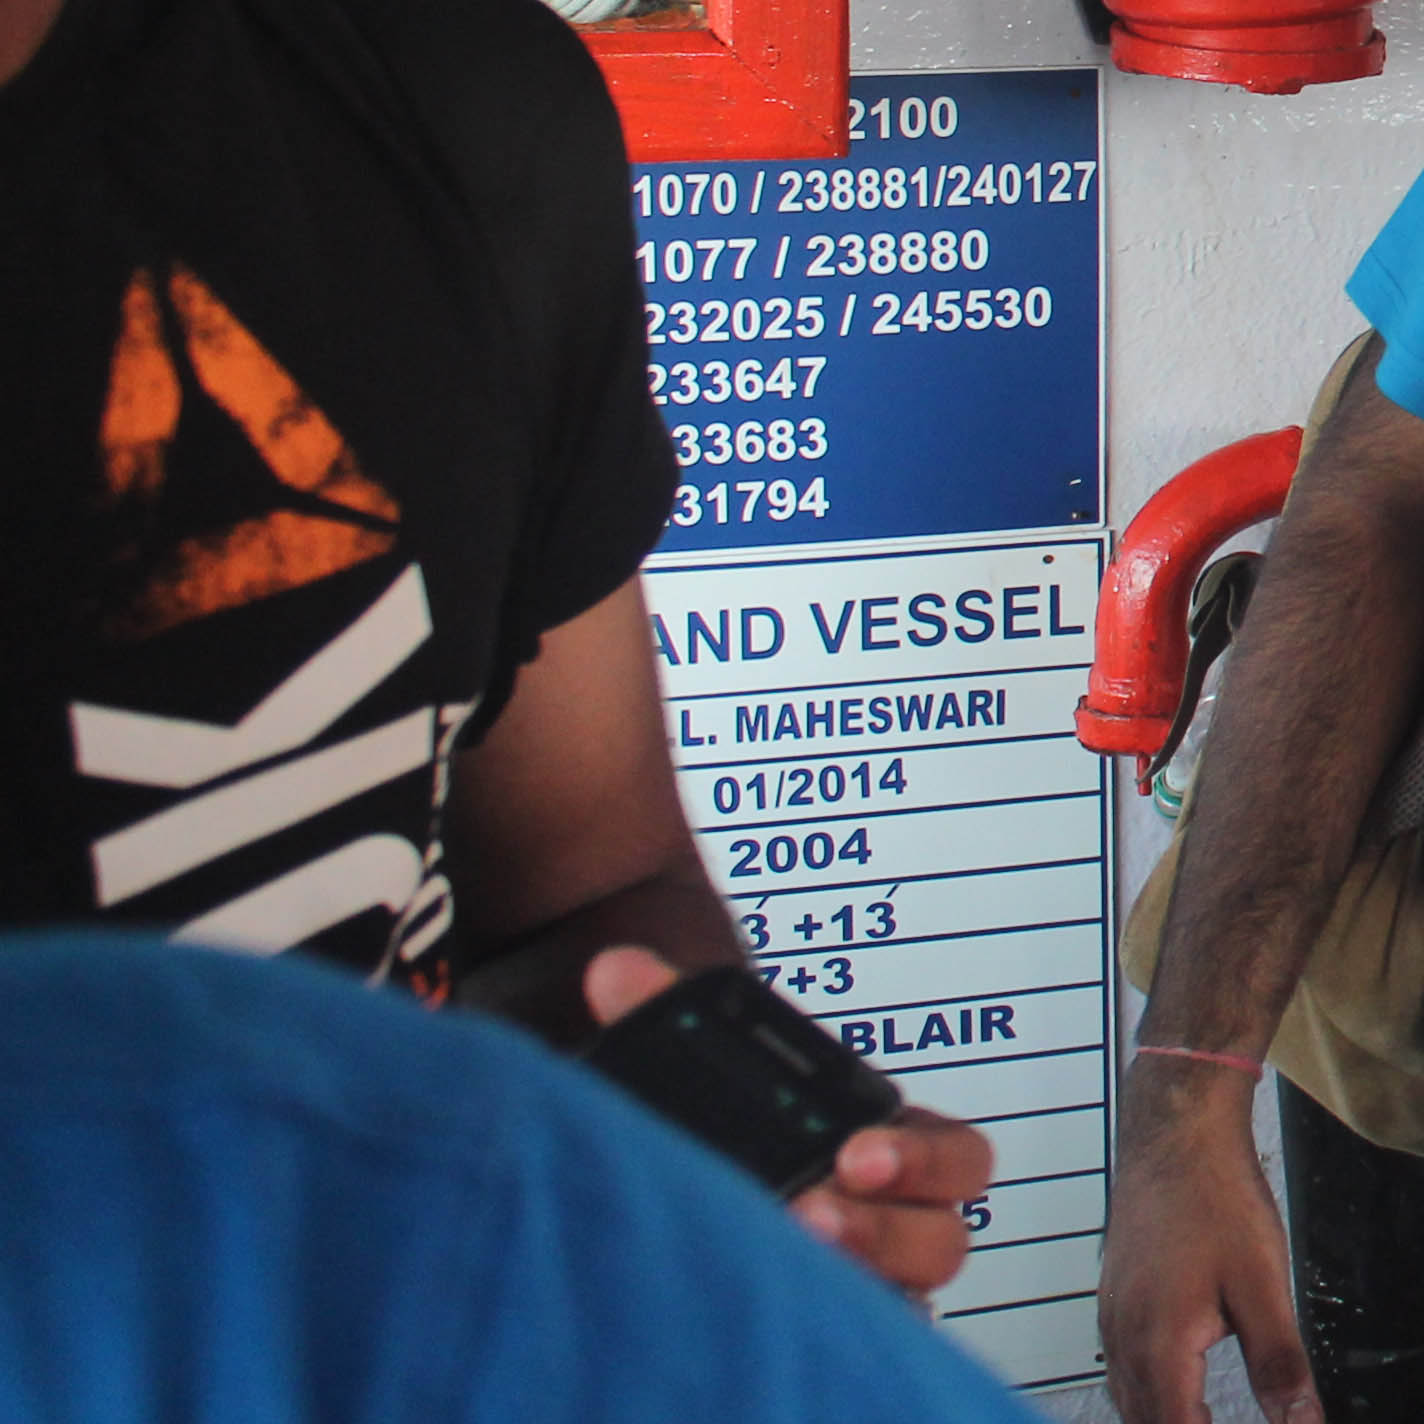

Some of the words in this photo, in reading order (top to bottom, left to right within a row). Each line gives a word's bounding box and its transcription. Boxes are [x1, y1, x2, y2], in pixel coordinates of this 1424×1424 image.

[849, 96, 959, 140] 2100
[632, 172, 738, 217] 1070
[749, 170, 766, 214] /
[776, 160, 1098, 214] 238881/240127
[635, 237, 758, 283] 1077
[771, 235, 792, 279] /
[805, 229, 990, 278] 238880
[644, 296, 825, 345] 232025
[837, 294, 857, 337] /
[871, 286, 1053, 335] 245530
[650, 356, 828, 406] 233647
[809, 583, 1085, 655] VESSEL
[736, 689, 1006, 744] MAHESWARI
[713, 757, 908, 816] 01/2014
[730, 828, 873, 878] 2004
[840, 1003, 1018, 1057] BLAIR
